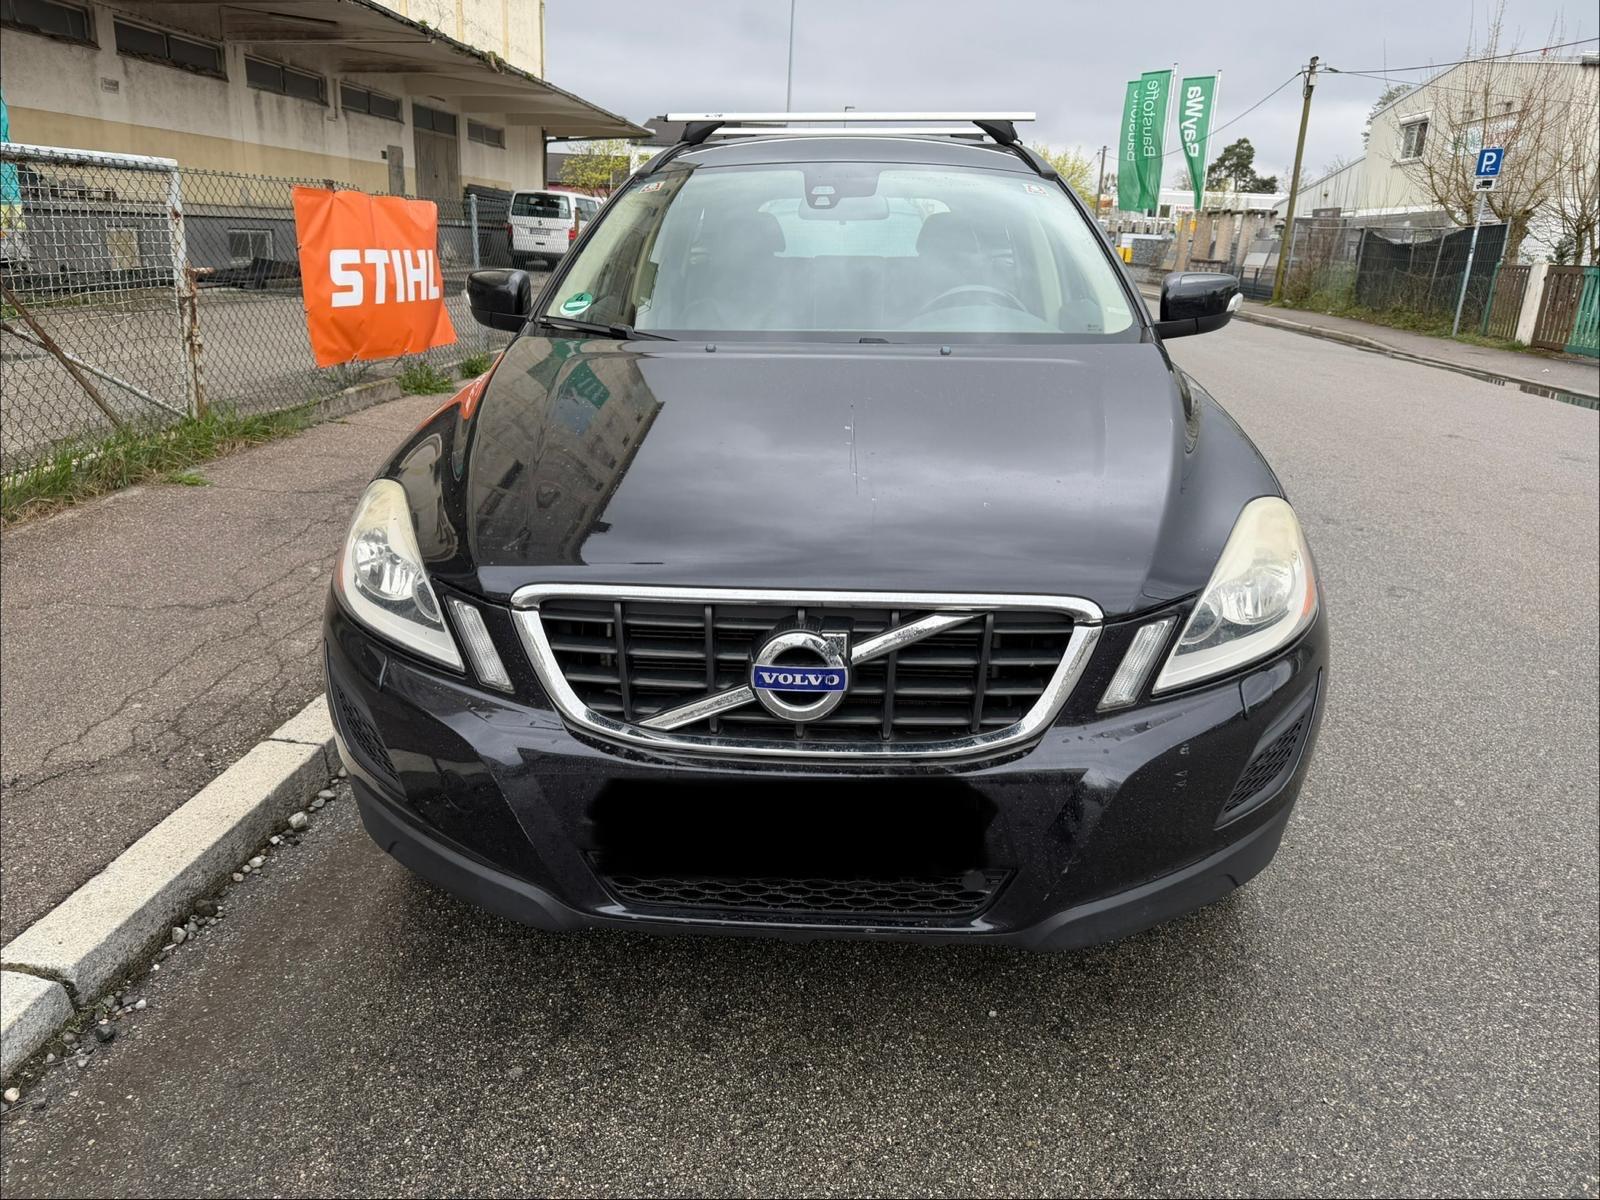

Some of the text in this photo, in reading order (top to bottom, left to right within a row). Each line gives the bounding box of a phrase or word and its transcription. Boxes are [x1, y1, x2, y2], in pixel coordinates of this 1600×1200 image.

[1481, 152, 1497, 173] P
[330, 249, 440, 308] STIHL
[760, 672, 840, 686] VOLVO
